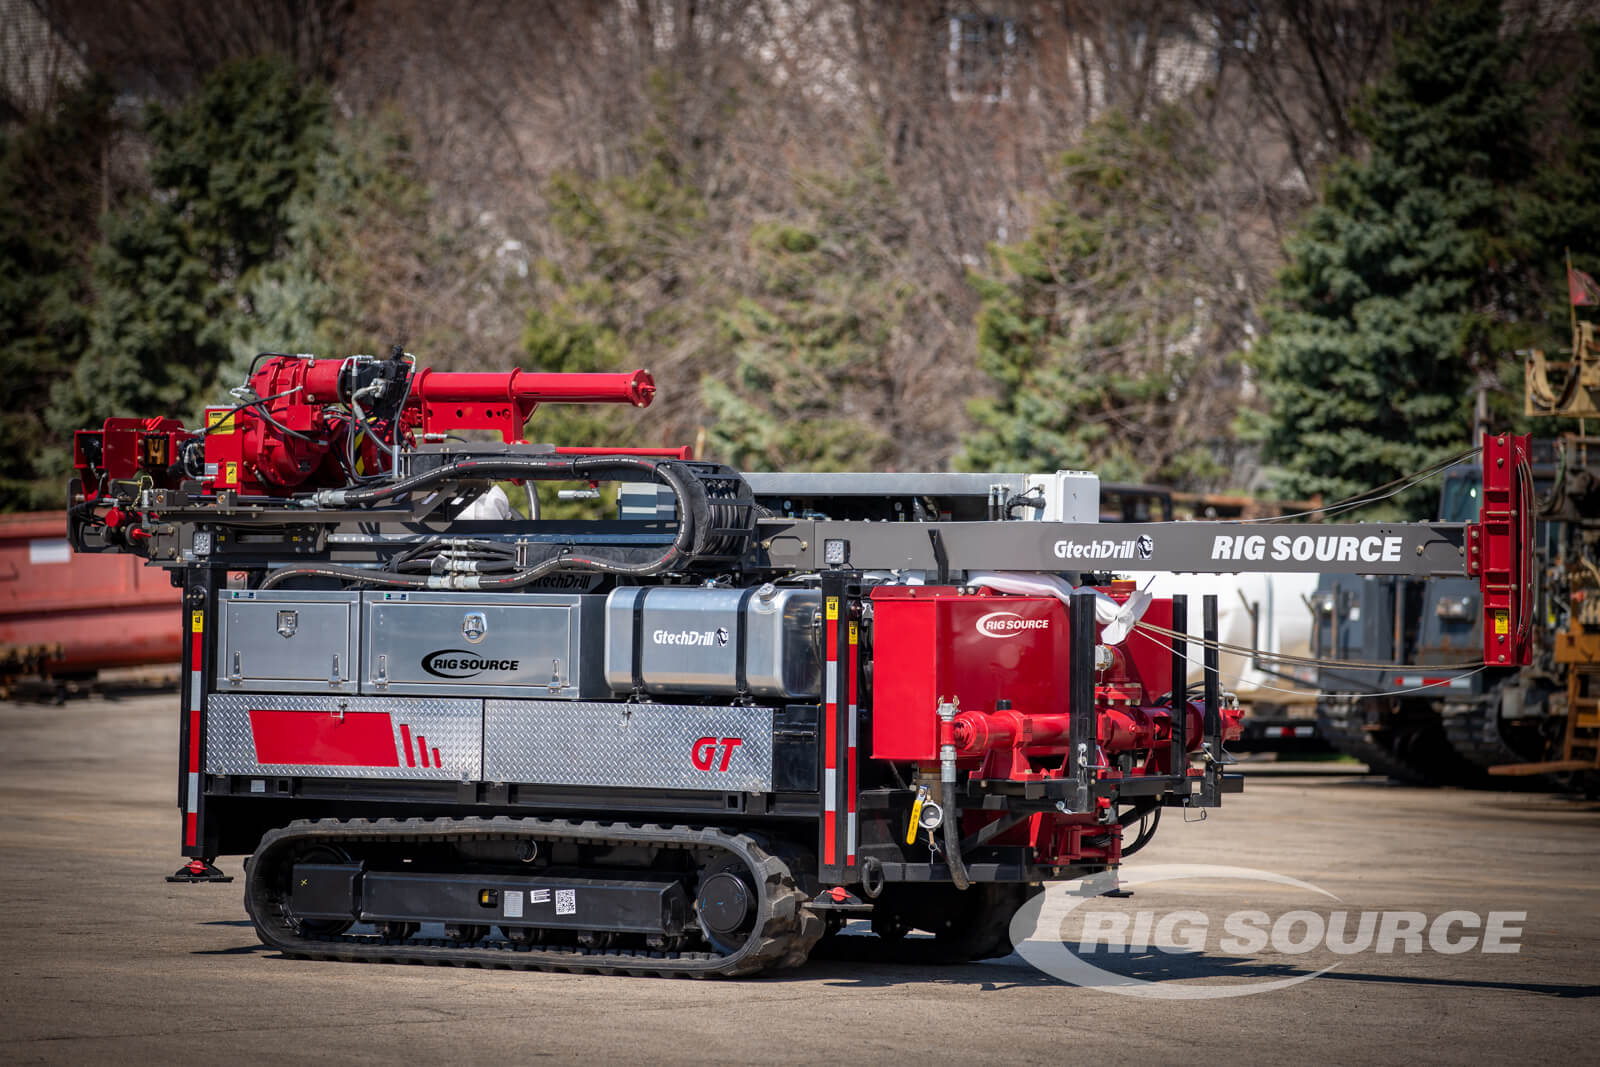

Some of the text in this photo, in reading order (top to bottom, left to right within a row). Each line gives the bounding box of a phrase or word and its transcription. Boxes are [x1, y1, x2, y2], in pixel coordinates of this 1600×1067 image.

[1053, 539, 1136, 560] GtechDrill
[1210, 535, 1403, 563] RIG SOURCE
[985, 619, 1049, 631] RIG SOURCE
[653, 629, 715, 646] GtechDrill
[433, 658, 520, 671] RIG SOURCE
[691, 737, 743, 772] GT
